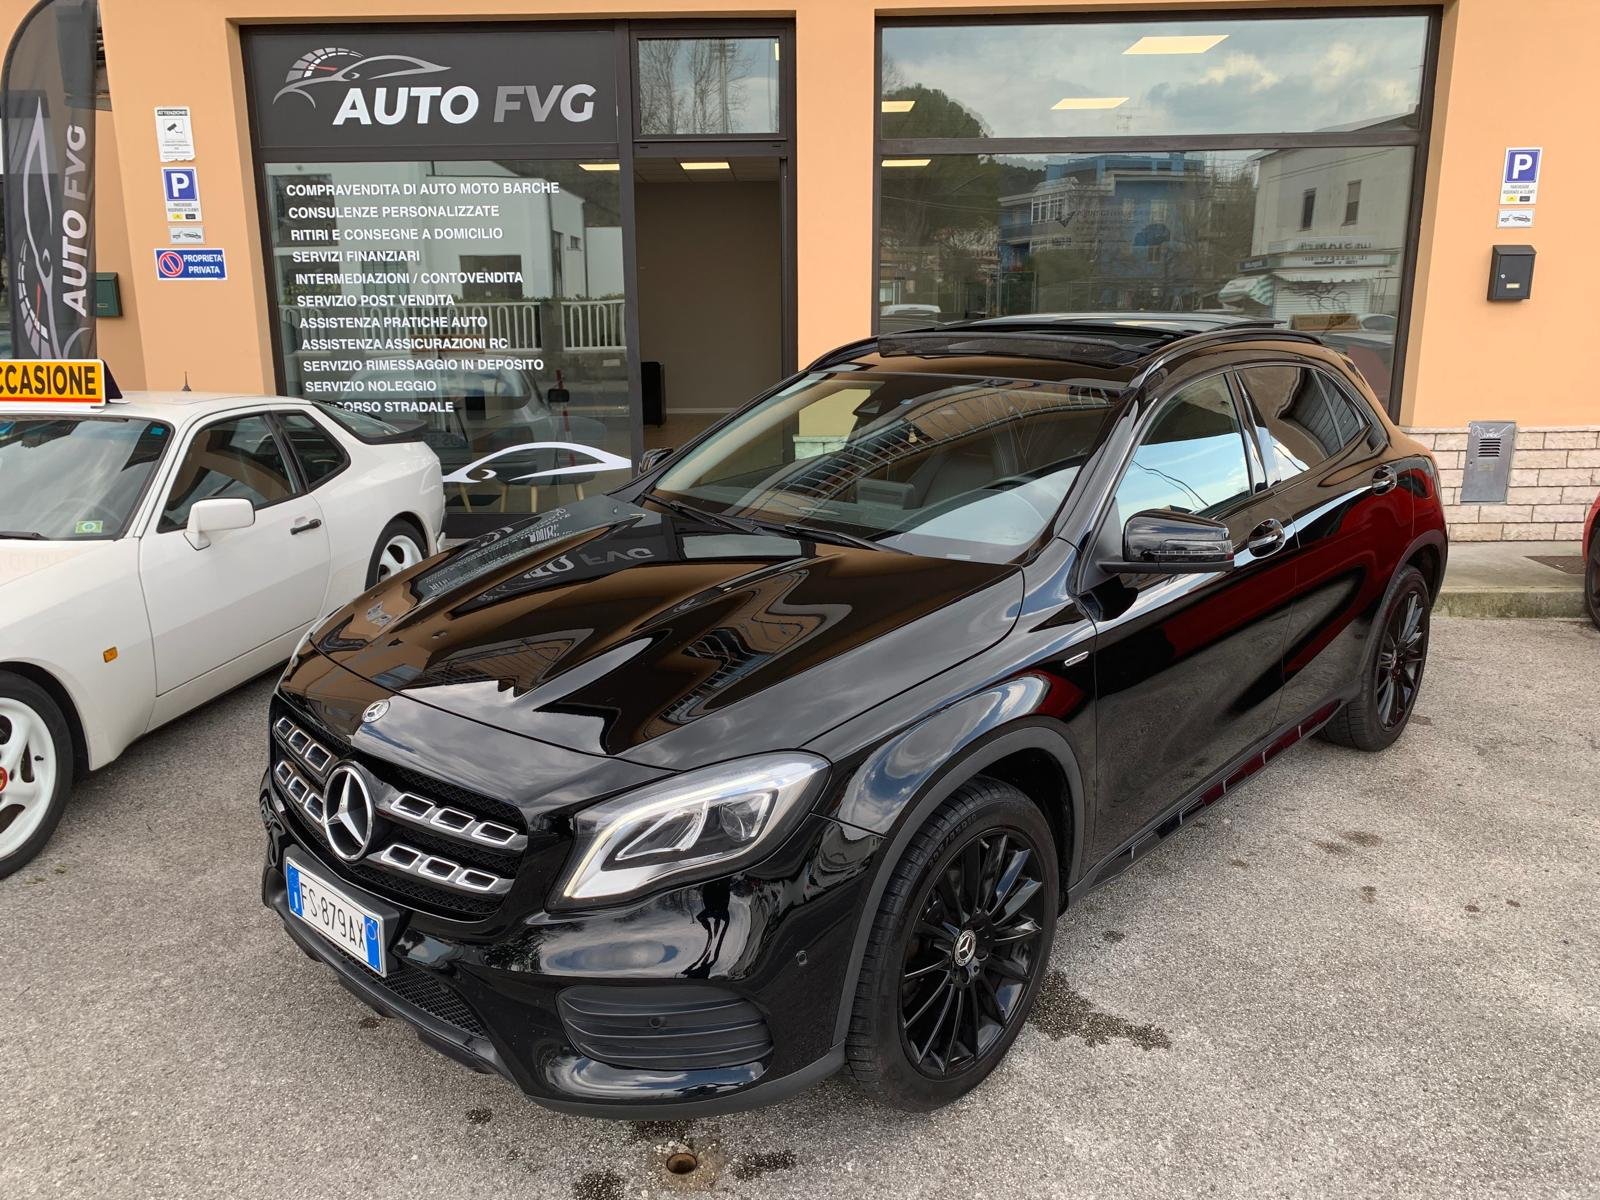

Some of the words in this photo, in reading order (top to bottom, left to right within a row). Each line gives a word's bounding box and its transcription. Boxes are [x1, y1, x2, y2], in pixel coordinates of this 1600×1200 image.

[332, 86, 480, 126] AUTO
[493, 84, 597, 123] FVG
[63, 124, 87, 201] FVG
[1512, 153, 1532, 179] P
[171, 172, 190, 198] P
[287, 184, 400, 196] COMPRAVENDITA
[403, 183, 417, 195] DI
[420, 183, 456, 195] AUTO
[460, 182, 500, 194] MOTO
[503, 182, 559, 194] BARCHE
[288, 207, 378, 218] CONSULENZE
[382, 205, 499, 218] PERSONALIZZATE
[291, 229, 329, 241] RITIRI
[332, 229, 340, 240] E
[344, 229, 419, 240] CONSEGNE
[422, 229, 431, 239] A
[434, 228, 502, 239] DOMICILIO
[292, 251, 343, 262] SERVIZI
[347, 251, 420, 262] FINANZIARI
[62, 213, 88, 318] AUTO
[188, 265, 221, 274] PRIVATA
[296, 273, 410, 284] INTERMEDIAZIONI
[413, 273, 418, 284] /
[421, 272, 523, 283] CONTOVENDITA
[297, 295, 357, 306] SERVIZIO
[361, 295, 395, 306] POST
[398, 295, 454, 305] VENDITA
[300, 317, 380, 328] ASSISTENZA
[384, 317, 448, 328] PRATICHE
[451, 317, 488, 327] AUTO
[302, 339, 382, 349] ASSISTENZA
[385, 338, 486, 349] ASSICURAZIONI
[489, 338, 508, 348] RC
[303, 360, 362, 371] SERVIZIO
[366, 360, 458, 371] RIMESSAGGIO
[461, 360, 474, 370] IN
[478, 360, 544, 370] DEPOSITO
[305, 381, 364, 392] SERVIZIO
[368, 381, 436, 391] NOLEGGIO
[384, 402, 453, 412] STRADALE
